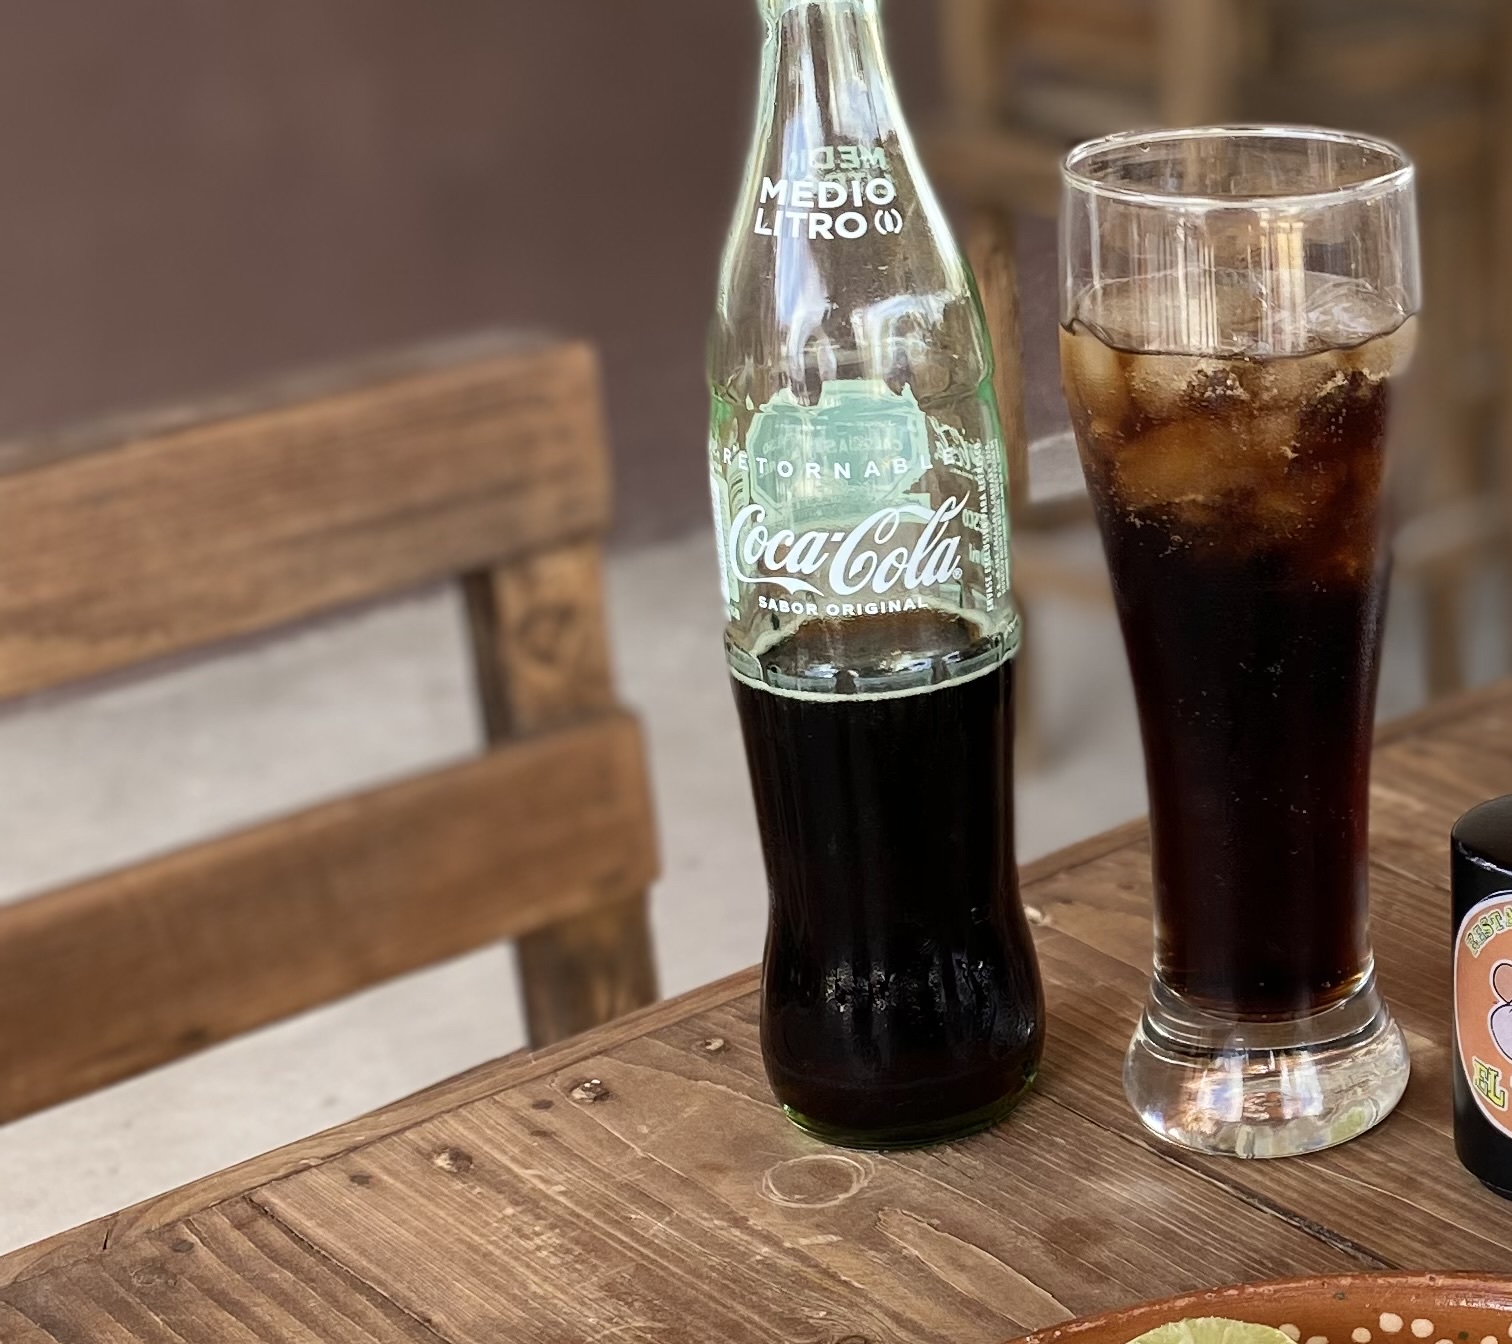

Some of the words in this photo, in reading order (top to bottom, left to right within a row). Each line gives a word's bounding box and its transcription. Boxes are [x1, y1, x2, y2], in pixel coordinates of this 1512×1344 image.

[760, 176, 895, 208] MEDIO
[754, 208, 867, 240] LITRO
[729, 490, 970, 596] Coca-Cola
[758, 596, 819, 616] SABOR
[826, 597, 928, 617] ORIGINAL
[1473, 1059, 1505, 1108] EL
